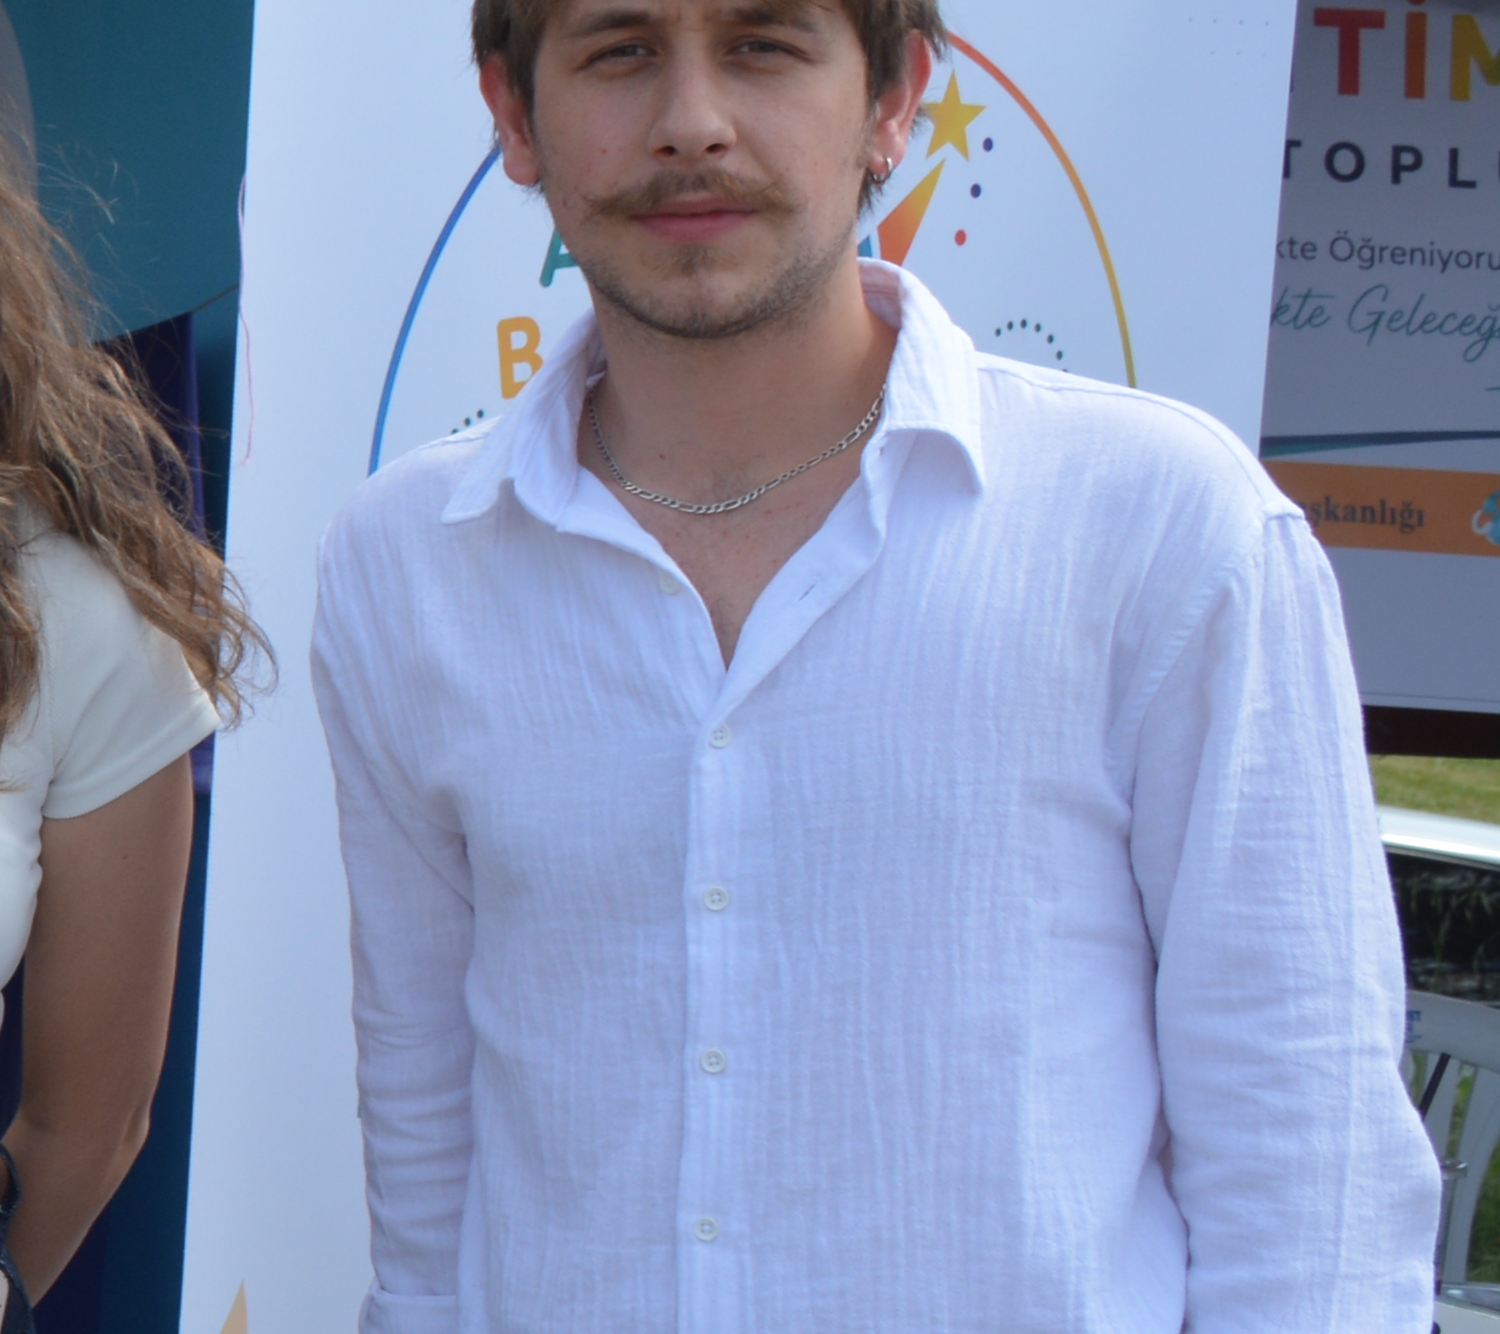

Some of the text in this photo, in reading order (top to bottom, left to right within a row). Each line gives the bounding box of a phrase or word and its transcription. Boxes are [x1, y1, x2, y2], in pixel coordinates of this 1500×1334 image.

[1282, 138, 1500, 190] TOPL
[1348, 283, 1500, 363] Geleceğ
[1303, 495, 1427, 534] şkanlığı
